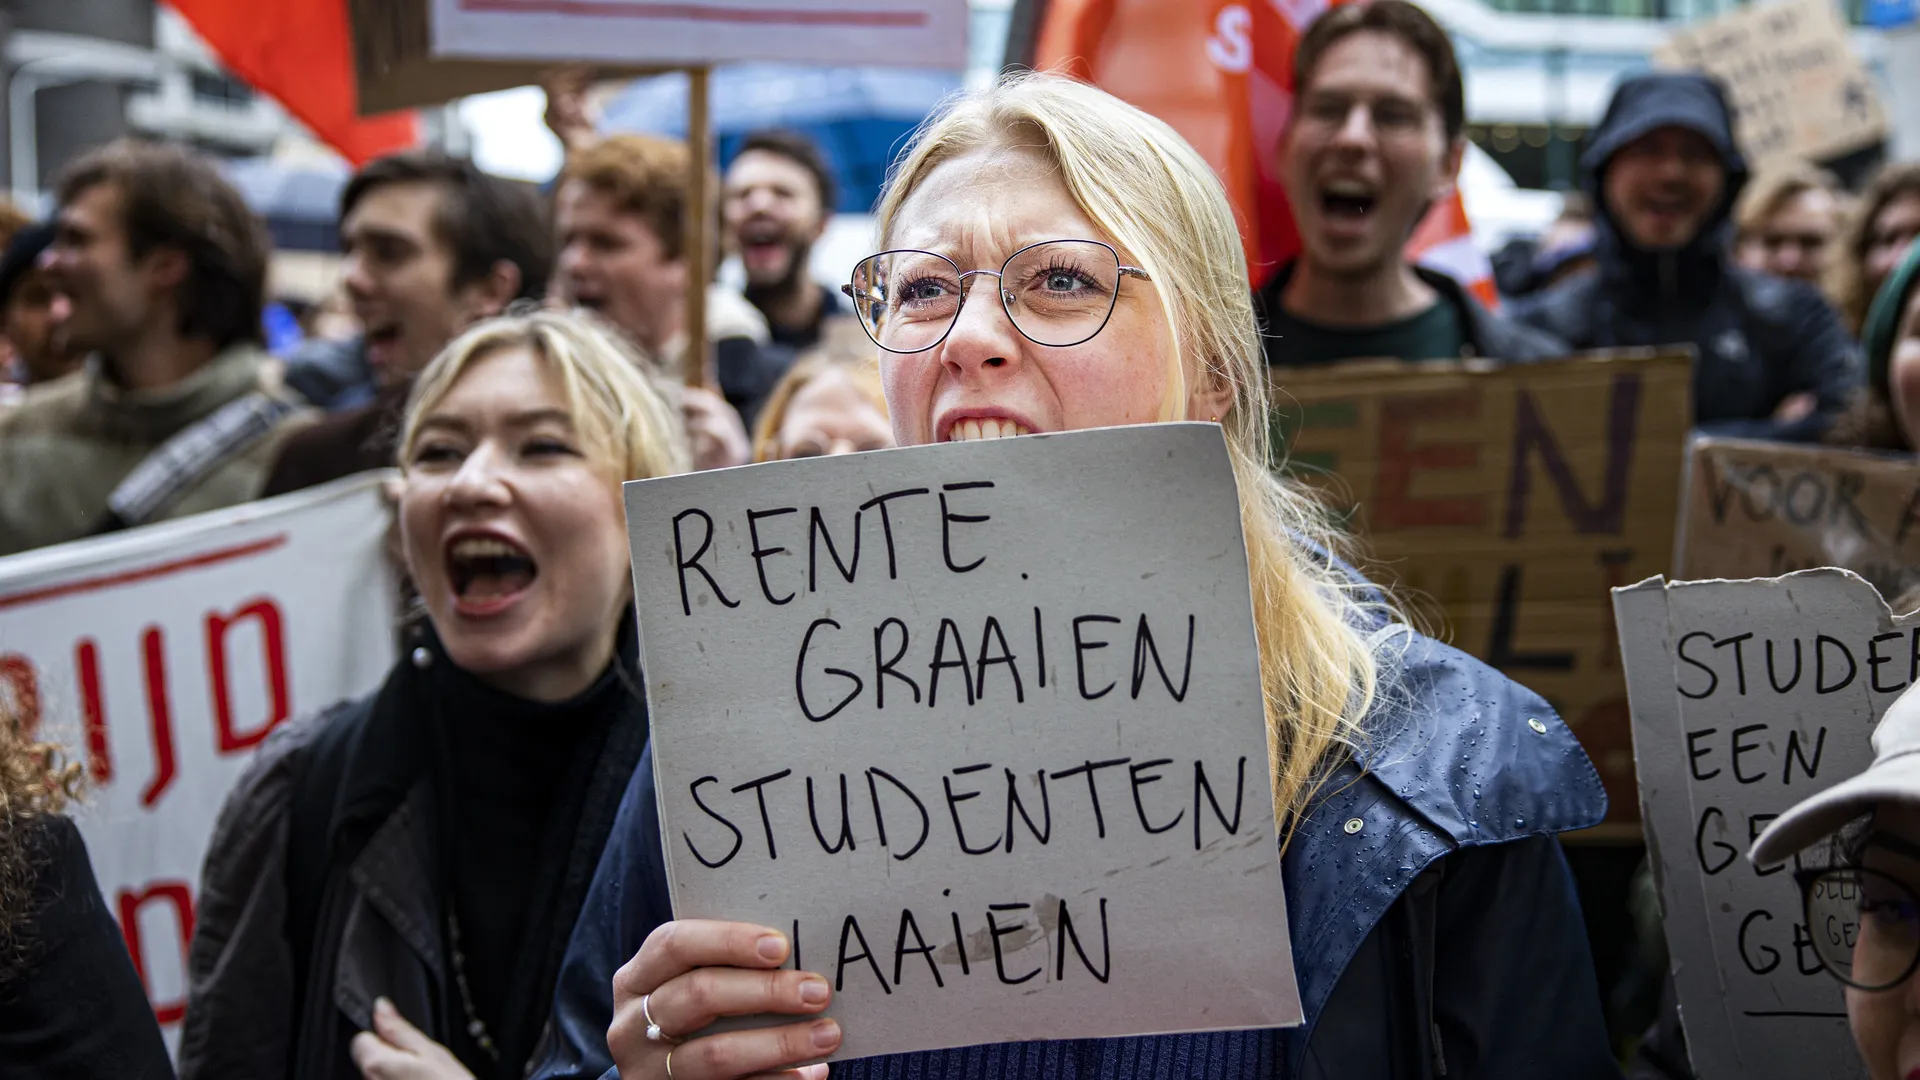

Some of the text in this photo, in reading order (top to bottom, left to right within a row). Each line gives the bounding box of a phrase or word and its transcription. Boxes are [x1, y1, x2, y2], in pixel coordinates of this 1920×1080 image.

[1700, 454, 1876, 542] VOOR
[796, 606, 1194, 722] GRAAIEN
[1686, 723, 1827, 785] EEN
[683, 756, 1246, 868] STUDENTEN
[1738, 910, 1827, 977] GE
